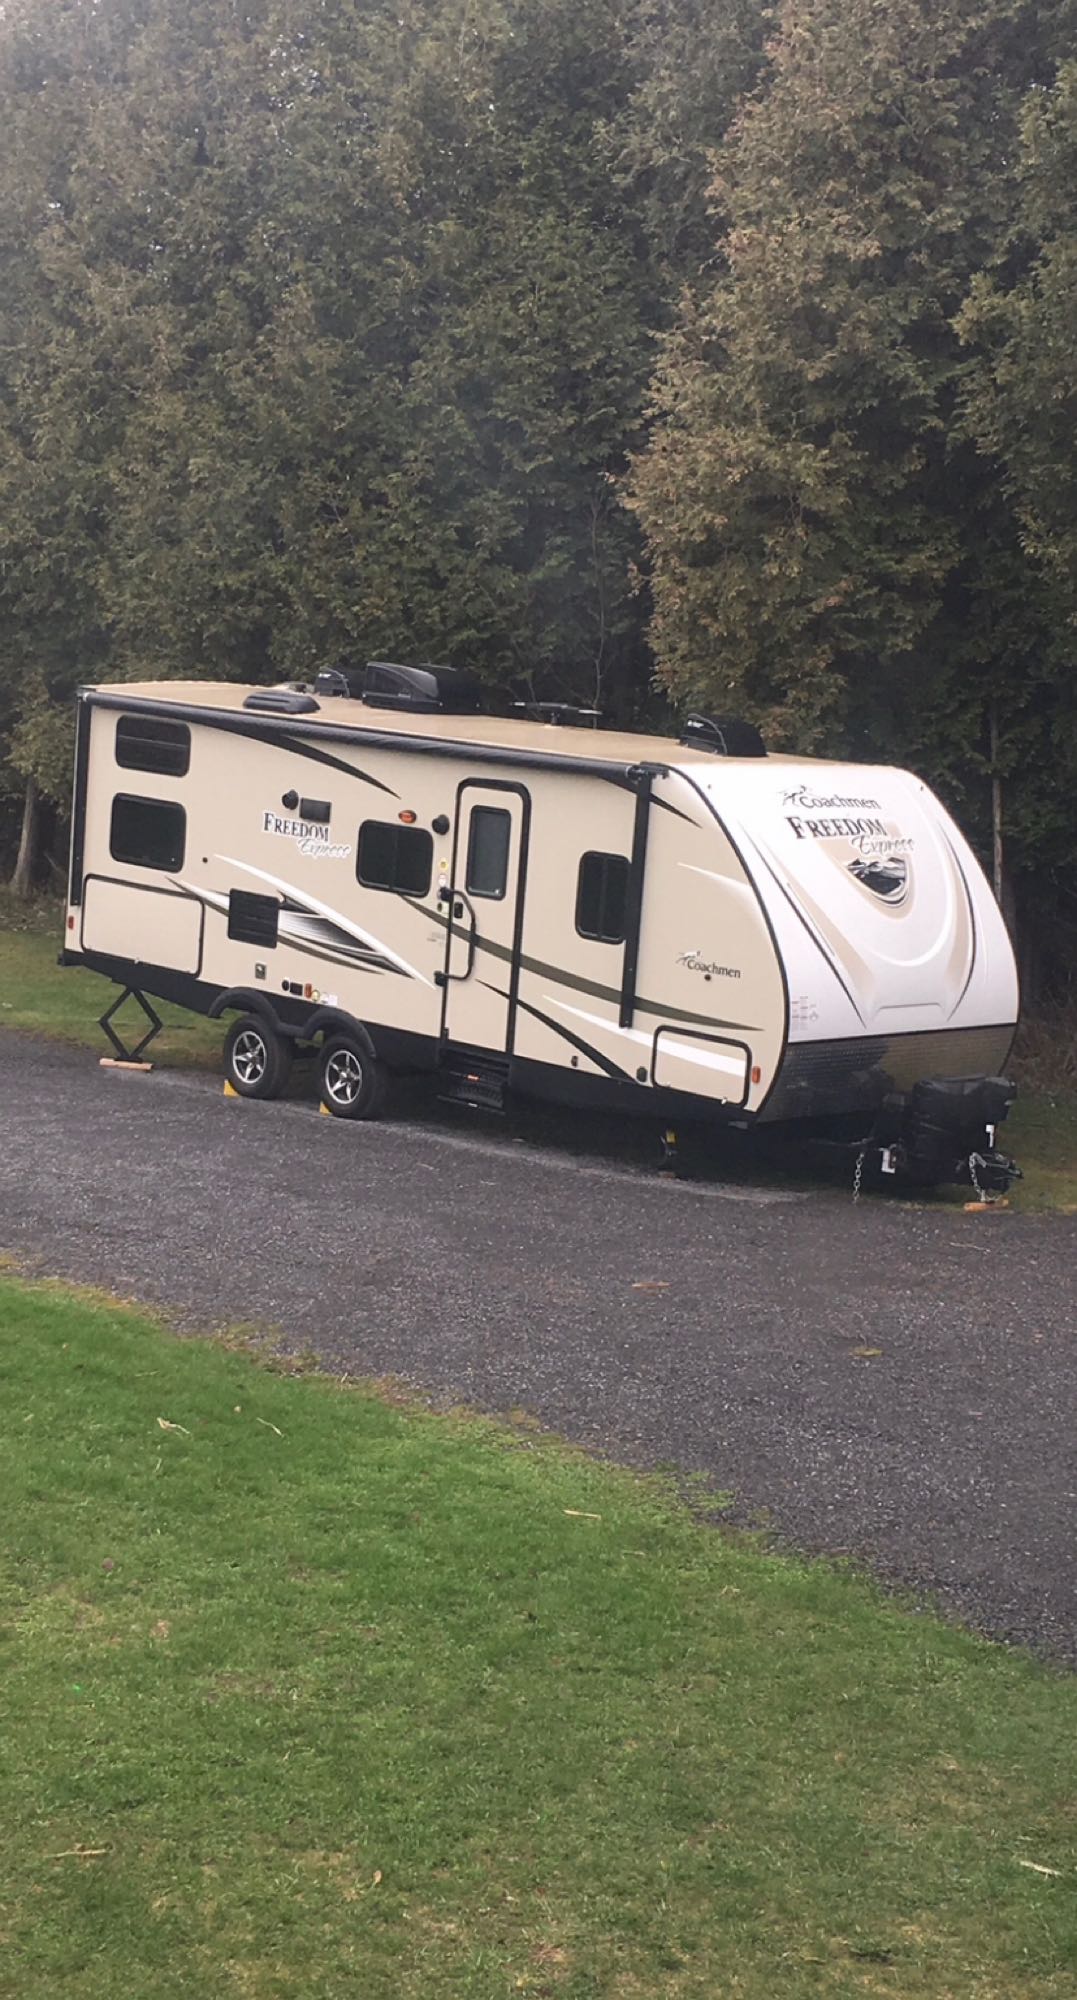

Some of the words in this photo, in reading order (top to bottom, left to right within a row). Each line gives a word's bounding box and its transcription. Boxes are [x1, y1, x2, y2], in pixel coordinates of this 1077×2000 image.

[799, 794, 881, 809] Coachmen
[264, 812, 329, 841] FREEDOM
[785, 816, 888, 839] FREEDOM
[687, 959, 741, 978] Coachmen
